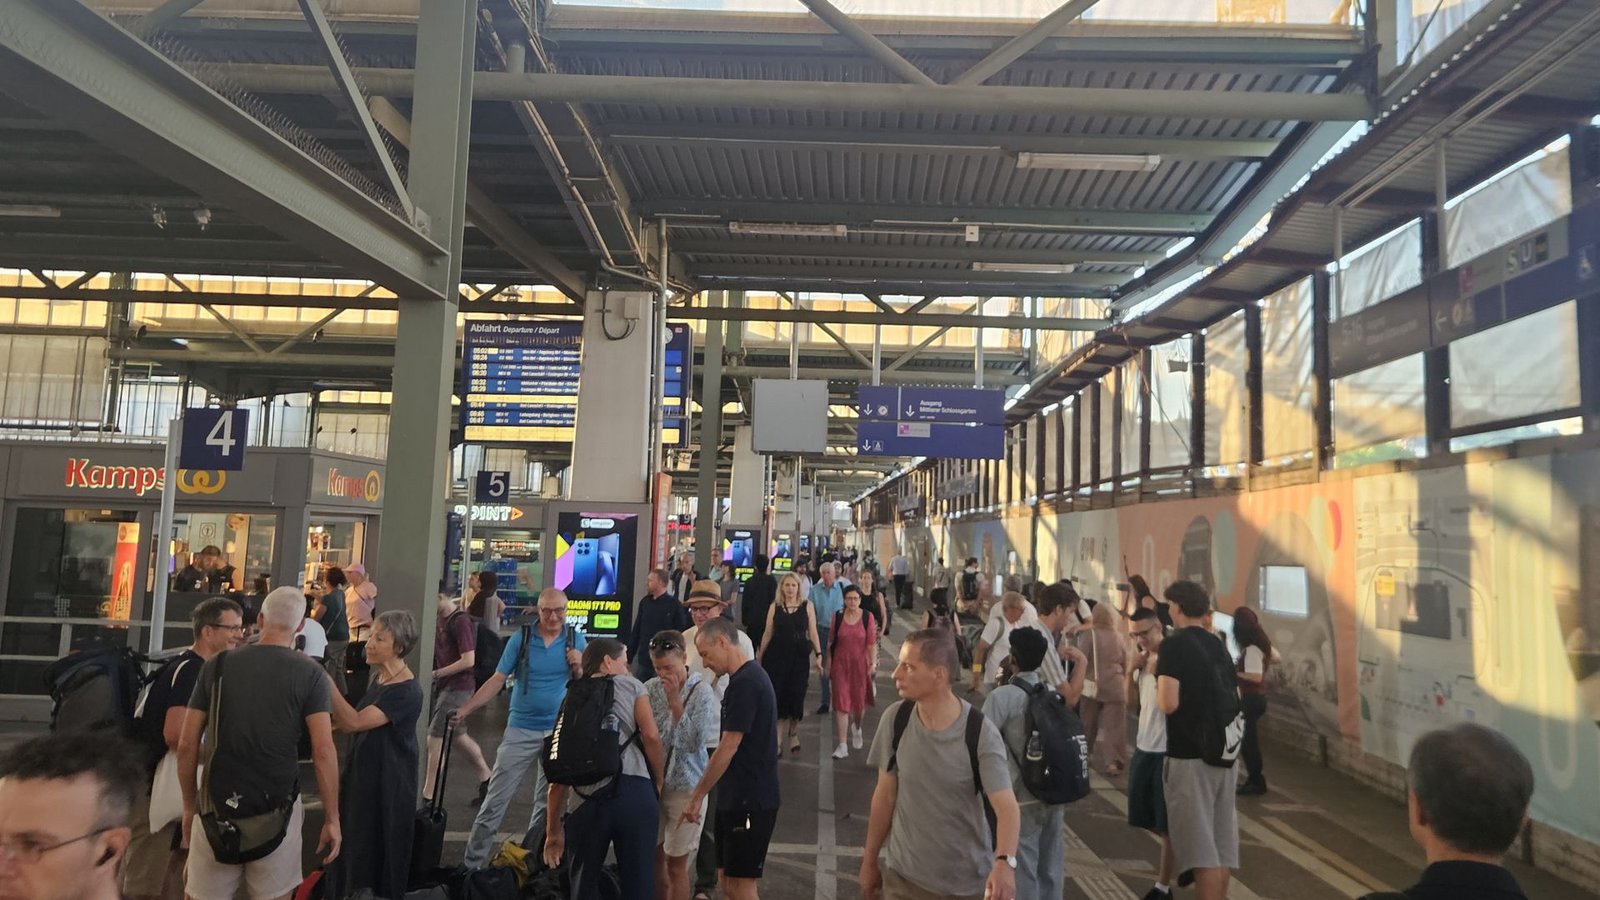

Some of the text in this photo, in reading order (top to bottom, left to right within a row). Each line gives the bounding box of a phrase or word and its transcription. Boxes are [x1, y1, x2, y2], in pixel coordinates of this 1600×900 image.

[470, 323, 501, 332] Abfahrt
[502, 325, 533, 334] Departure
[538, 326, 560, 335] Départ
[919, 400, 942, 408] Ausgang
[205, 410, 236, 457] 4
[65, 458, 165, 496] Kamps
[327, 467, 365, 499] Kamps
[488, 472, 505, 497] 5
[684, 513, 690, 524] 9
[605, 601, 621, 611] PRO
